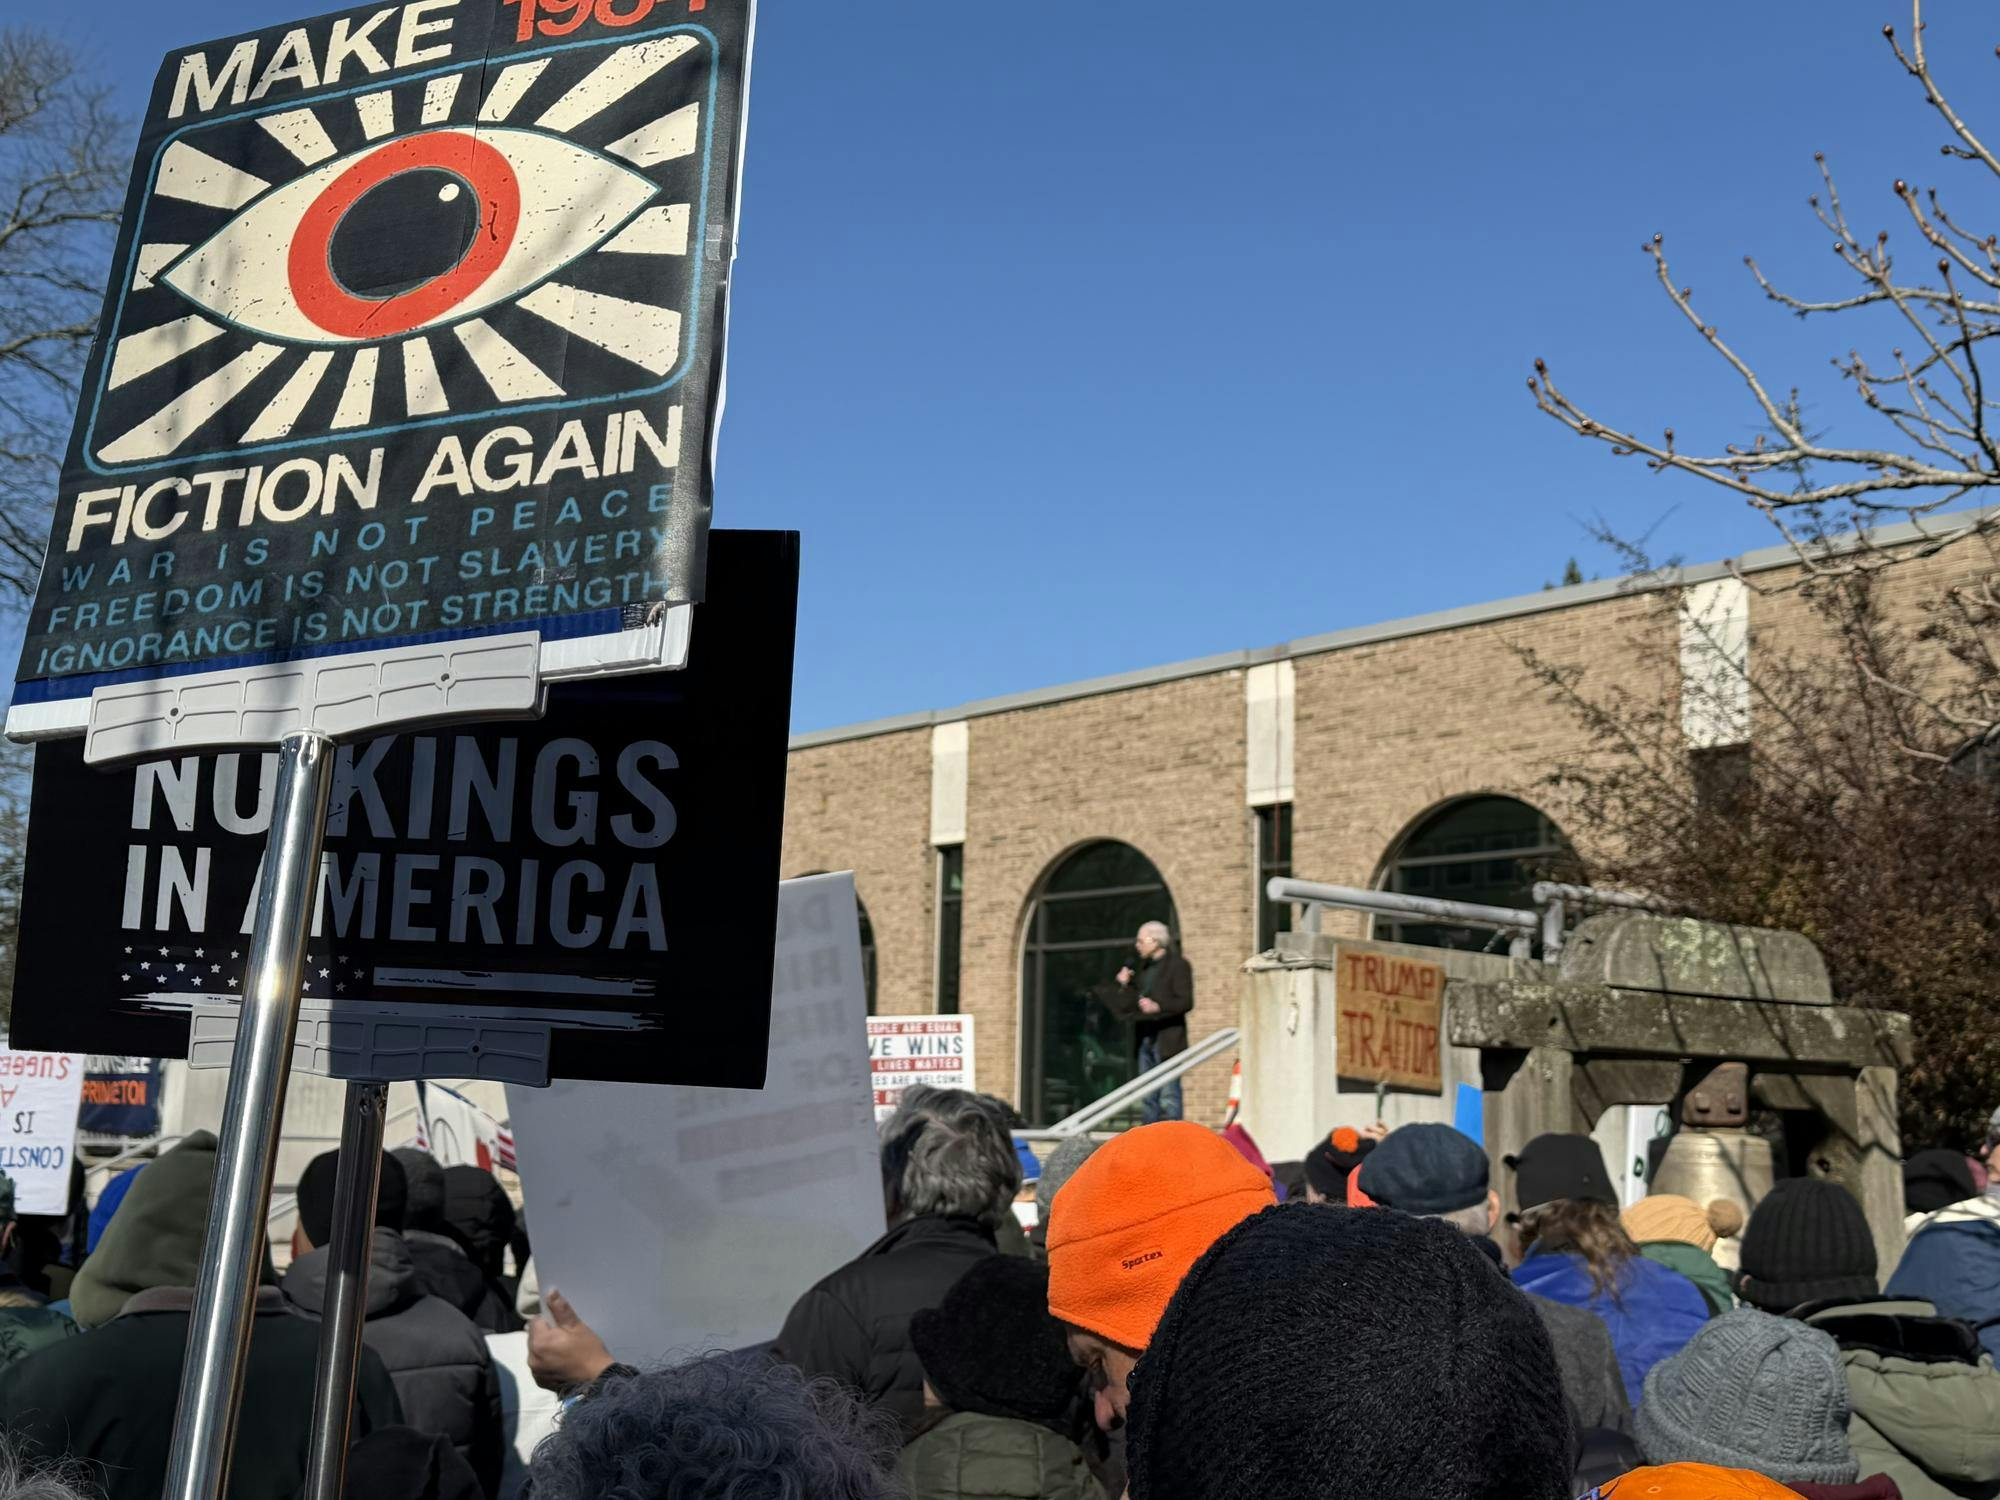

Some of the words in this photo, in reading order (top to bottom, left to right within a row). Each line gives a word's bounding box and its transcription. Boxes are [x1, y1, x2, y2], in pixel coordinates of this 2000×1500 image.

[168, 0, 460, 119] MAKE
[504, 0, 706, 42] 19
[66, 447, 385, 552] FICTION
[411, 405, 683, 503] AGAIN
[47, 578, 264, 633] FREEDOM
[284, 571, 325, 602] IS
[346, 555, 440, 593] NOT
[459, 526, 673, 580] SLAVERY
[62, 551, 176, 592] WAR
[218, 538, 270, 569] IS
[311, 516, 430, 557] NOT
[470, 483, 674, 536] PEACE
[36, 618, 279, 674] IGNORANCE
[292, 612, 328, 645] IS
[341, 600, 429, 637] NOT
[440, 570, 672, 625] STRENGTH
[325, 735, 680, 849] KINGS
[121, 844, 212, 932] IN
[239, 847, 669, 951] MERICA
[1346, 954, 1436, 1000] TRUMP
[902, 1022, 924, 1033] ARE
[926, 1021, 959, 1032] EQUAL
[907, 1036, 963, 1055] WINS
[914, 1058, 960, 1070] MATTER
[1342, 1009, 1438, 1076] TRAITOR
[891, 1075, 910, 1085] ARE
[915, 1073, 964, 1084] WELCOME
[13, 1111, 36, 1134] IS
